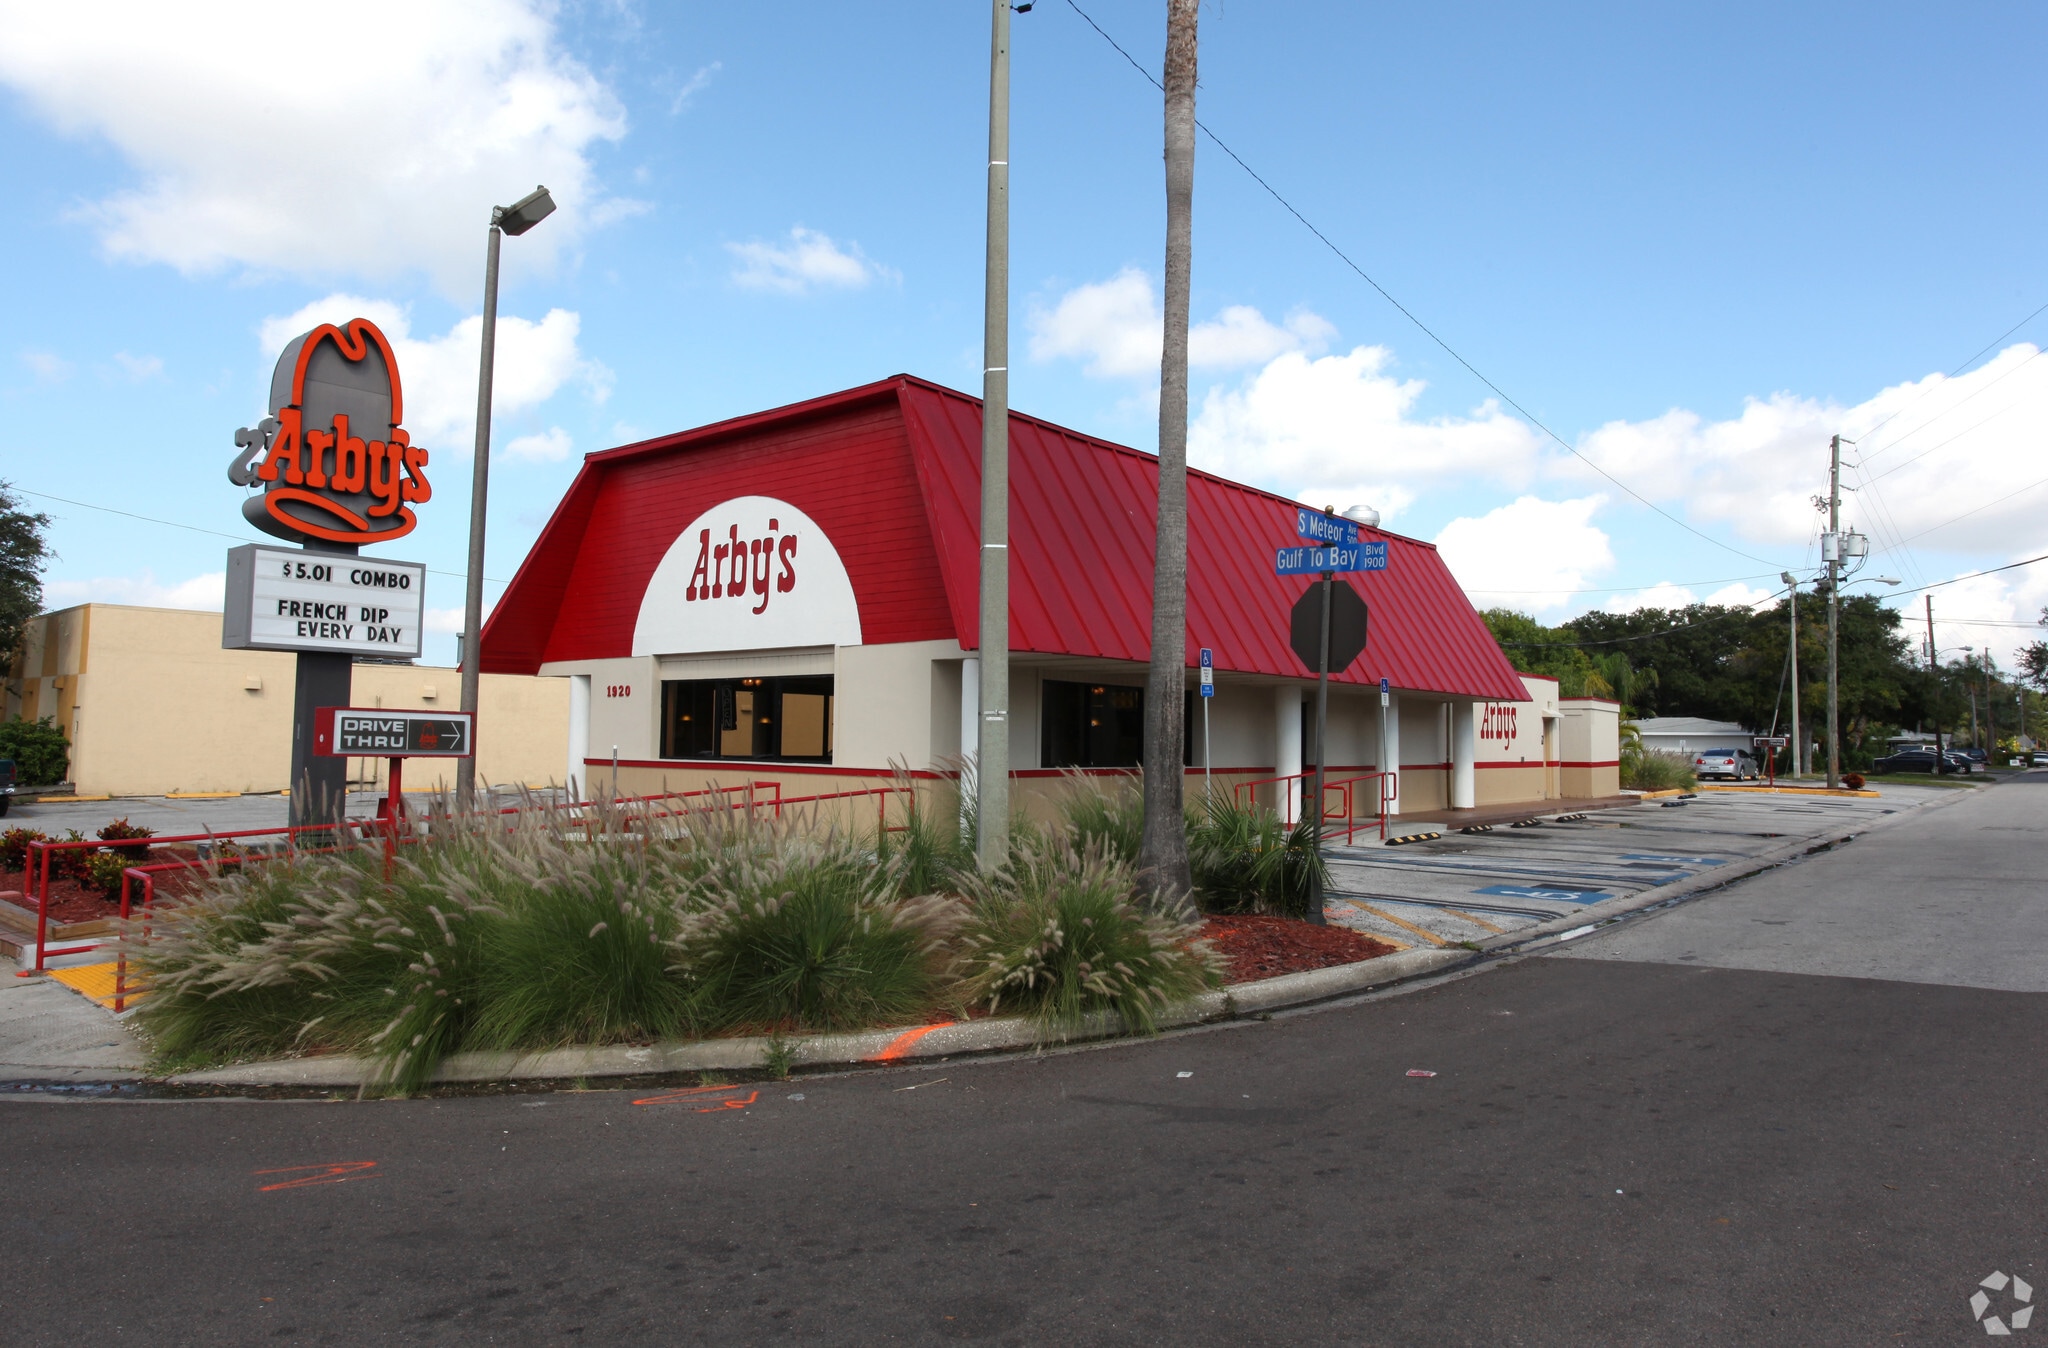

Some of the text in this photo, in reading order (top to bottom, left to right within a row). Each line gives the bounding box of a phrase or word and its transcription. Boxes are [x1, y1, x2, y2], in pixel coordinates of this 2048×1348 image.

[258, 407, 432, 517] Arby's
[1298, 512, 1357, 542] S Meteor Ave
[686, 518, 797, 615] Arby's
[1277, 544, 1384, 570] Gulf To Bay Blvd
[1364, 556, 1385, 568] 1900
[350, 569, 410, 590] COMBO
[278, 599, 389, 624] FRENCH DIP
[297, 621, 401, 643] EVERY DAY
[607, 685, 631, 698] 1920
[344, 719, 405, 733] DRIVE
[344, 735, 404, 748] THRU
